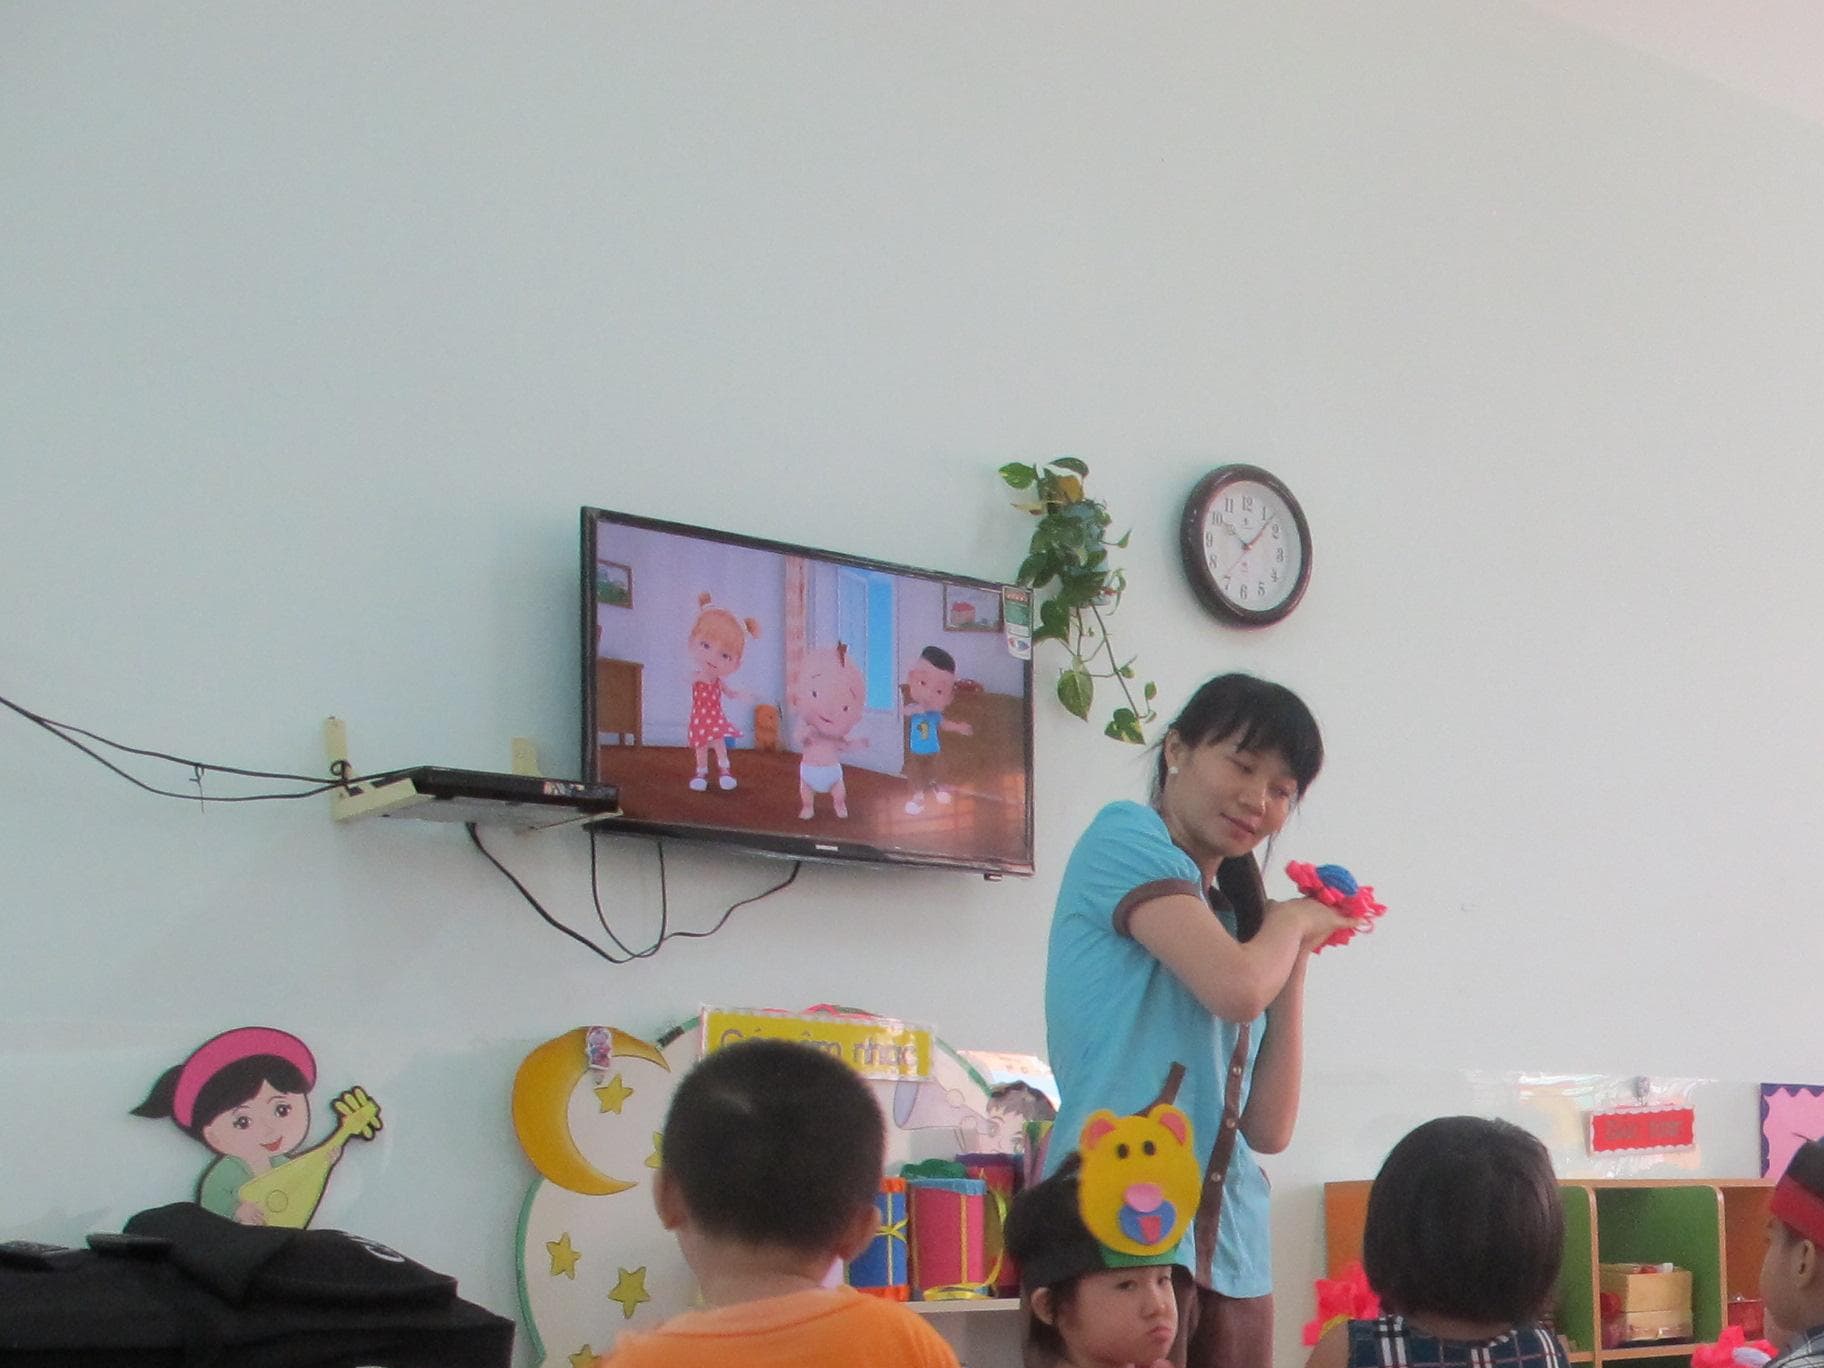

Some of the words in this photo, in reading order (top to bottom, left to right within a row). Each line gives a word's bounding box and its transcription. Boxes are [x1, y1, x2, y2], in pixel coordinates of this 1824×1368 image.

[1225, 498, 1233, 513] 11
[1241, 496, 1253, 512] 12
[1212, 511, 1223, 527] 10
[1206, 531, 1213, 548] 9
[1272, 523, 1280, 540] 2
[1209, 554, 1217, 569] 8
[1276, 547, 1284, 562] 3
[1224, 575, 1231, 591] 7
[1271, 568, 1279, 583] 4
[1240, 583, 1248, 600] 6
[1257, 582, 1266, 597] 5
